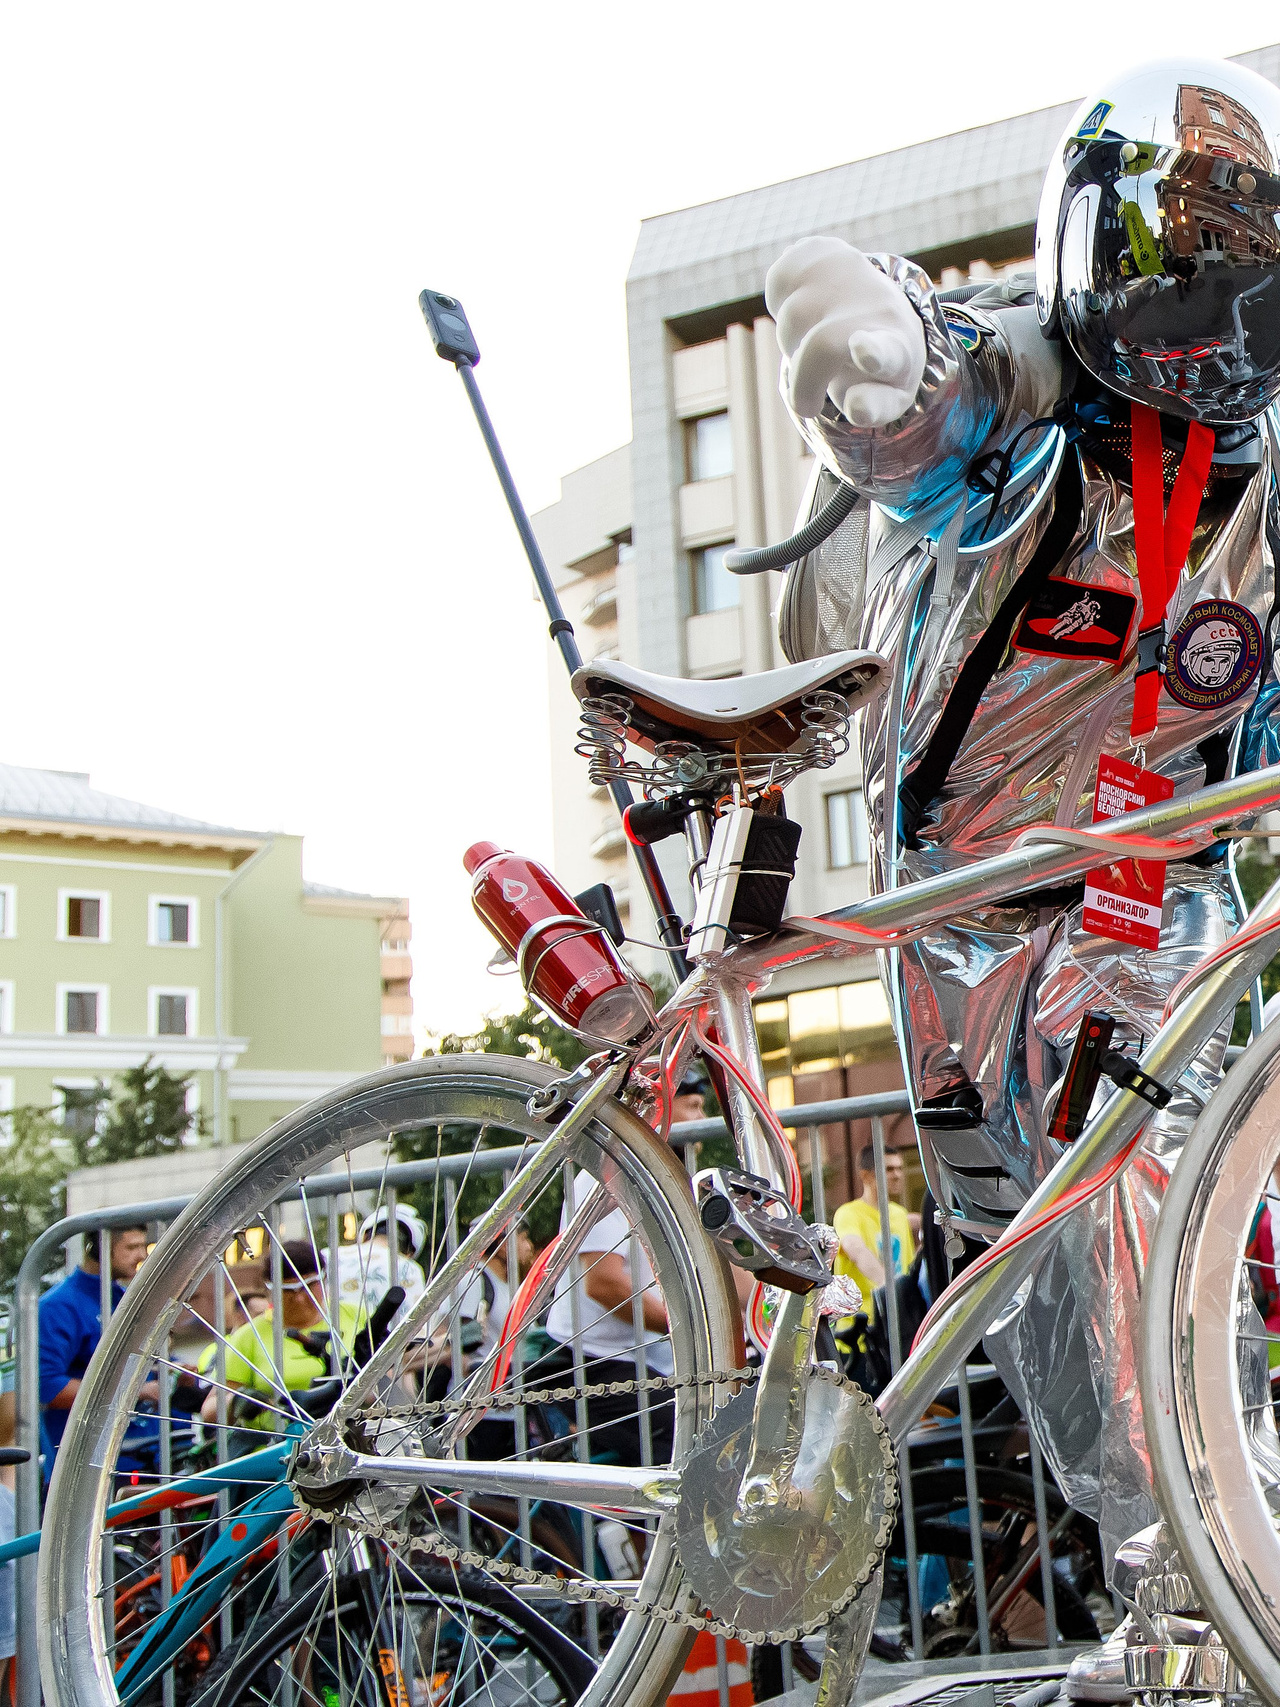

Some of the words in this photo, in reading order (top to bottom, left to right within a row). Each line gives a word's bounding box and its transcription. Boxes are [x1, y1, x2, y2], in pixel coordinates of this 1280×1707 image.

[1177, 604, 1219, 634] ПЕРВЫЙ
[1221, 606, 1258, 656] КОСМОНАВТ
[1167, 643, 1176, 673] ЮРИЙ
[1168, 674, 1217, 704] АЛЕКСЕЕВИЧ
[1218, 668, 1251, 700] ГАГАРИН
[1098, 791, 1126, 810] НОЧНОЙ
[1099, 780, 1146, 807] МОСКОВСКИЙ
[510, 894, 541, 917] BONTEL
[1096, 894, 1150, 920] ОРГАНИЗАТОР
